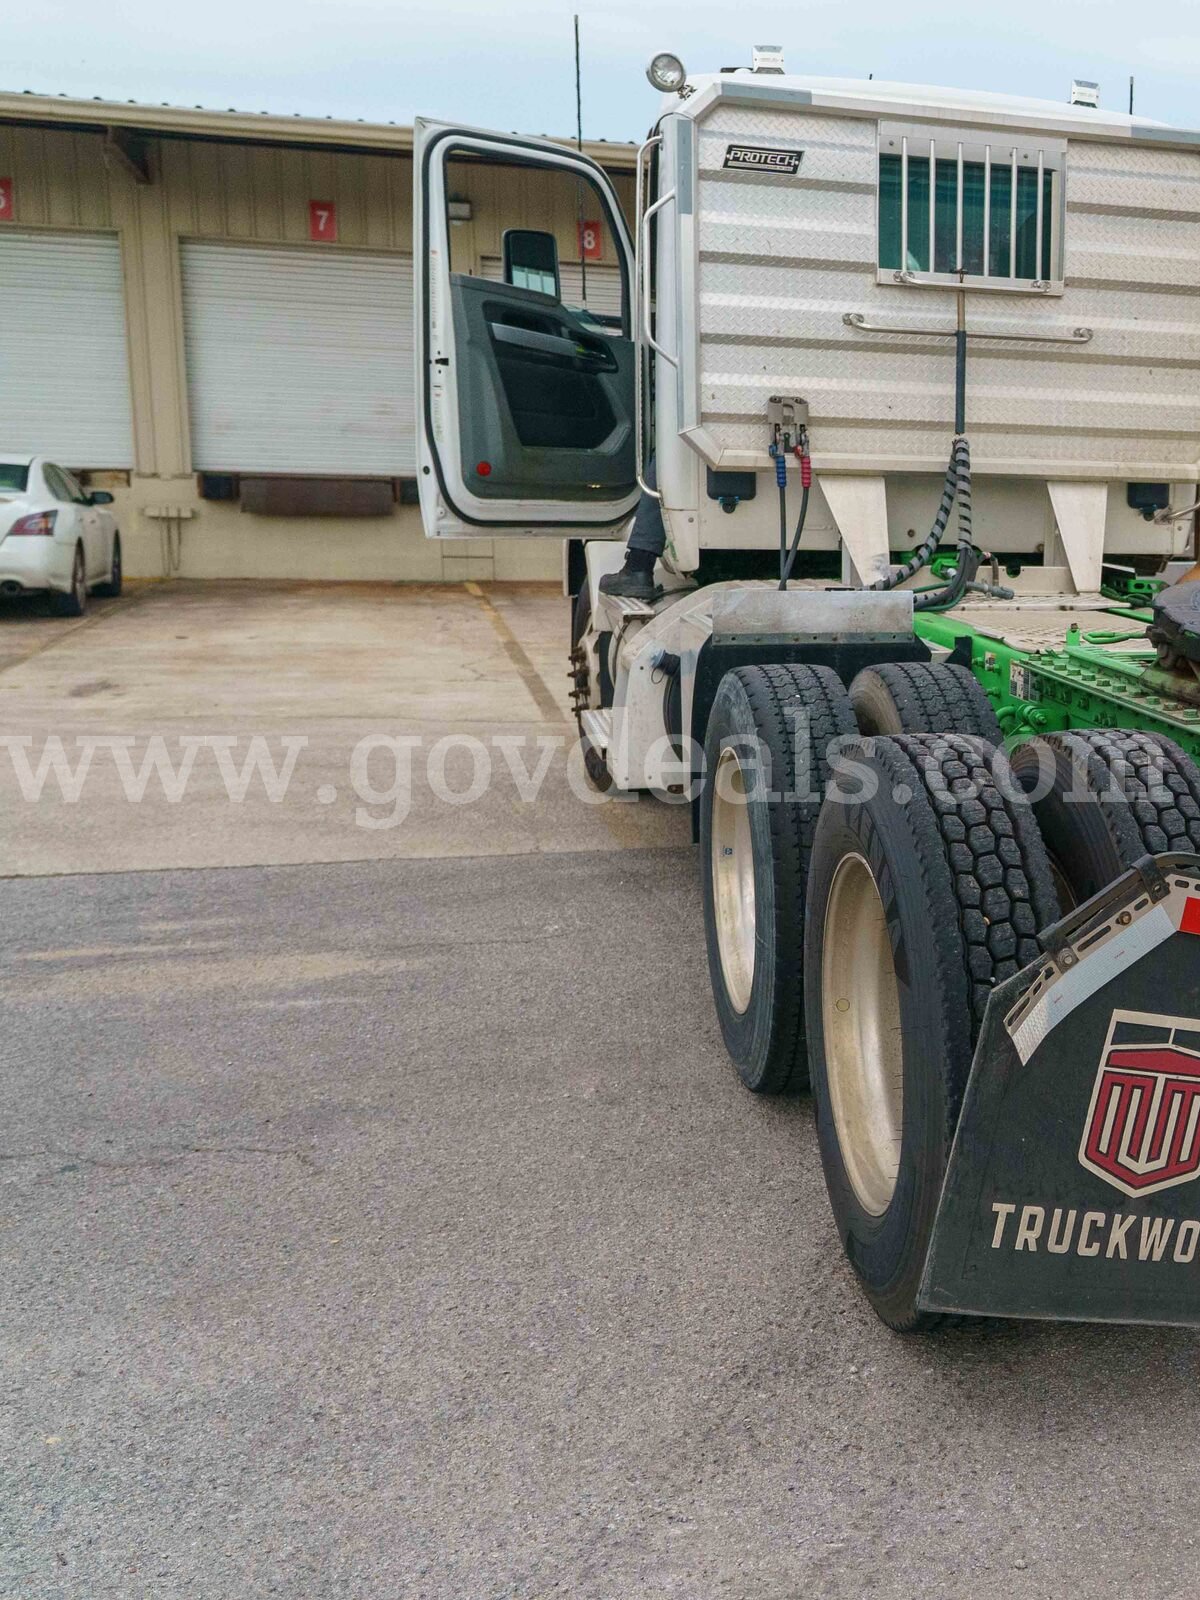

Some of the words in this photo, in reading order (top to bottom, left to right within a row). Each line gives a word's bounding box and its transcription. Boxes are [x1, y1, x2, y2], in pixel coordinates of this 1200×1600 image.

[729, 150, 797, 166] PROTECH
[315, 210, 329, 231] 7
[583, 229, 596, 250] 8
